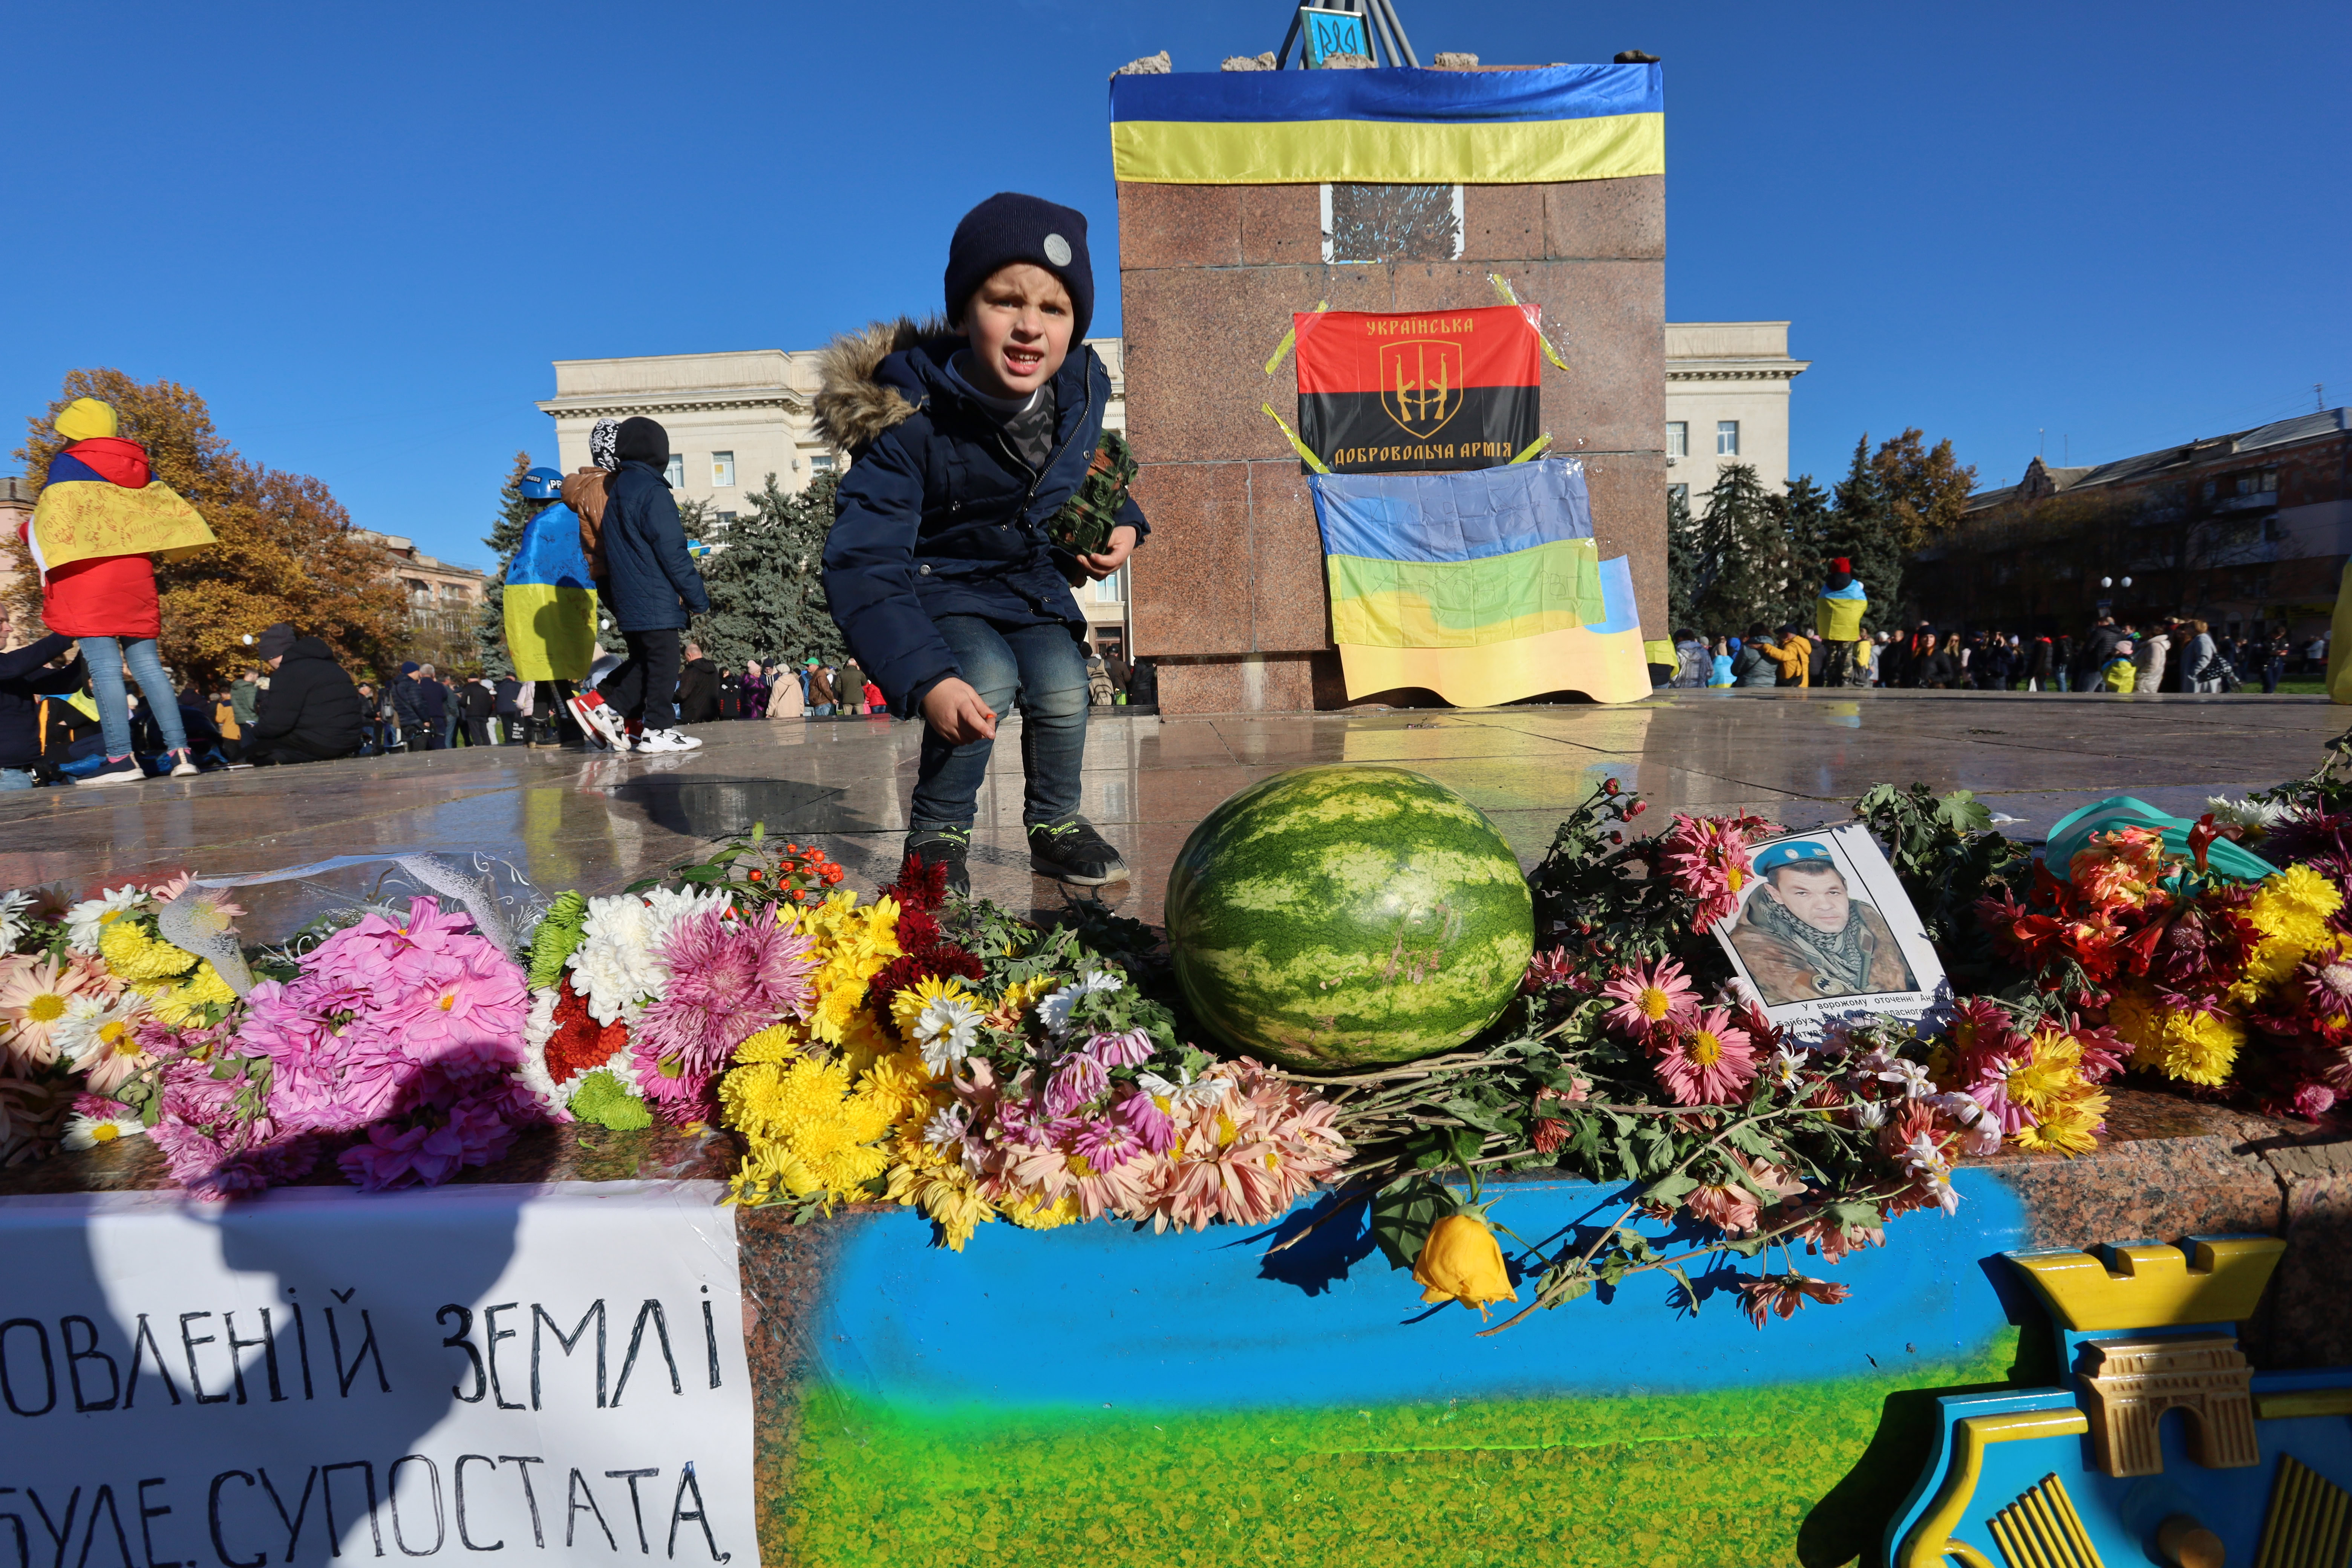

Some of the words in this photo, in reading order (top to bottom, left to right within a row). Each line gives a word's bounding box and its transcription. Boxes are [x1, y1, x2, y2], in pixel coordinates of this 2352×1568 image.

[1367, 317, 1473, 335] УКРАЇНСЬКА
[1335, 444, 1454, 466] ДОБРОВОЛЬЧА
[1460, 442, 1511, 458] АРМІЯ
[1370, 573, 1496, 605] ХЕРСОН
[1817, 999, 1867, 1009] ворожому
[1874, 994, 1914, 1004] оточенні
[1920, 994, 1949, 1003] Андрій
[436, 1285, 721, 1411] ЗЕМЛІ
[208, 1454, 731, 1568] СУПОСТАТА,
